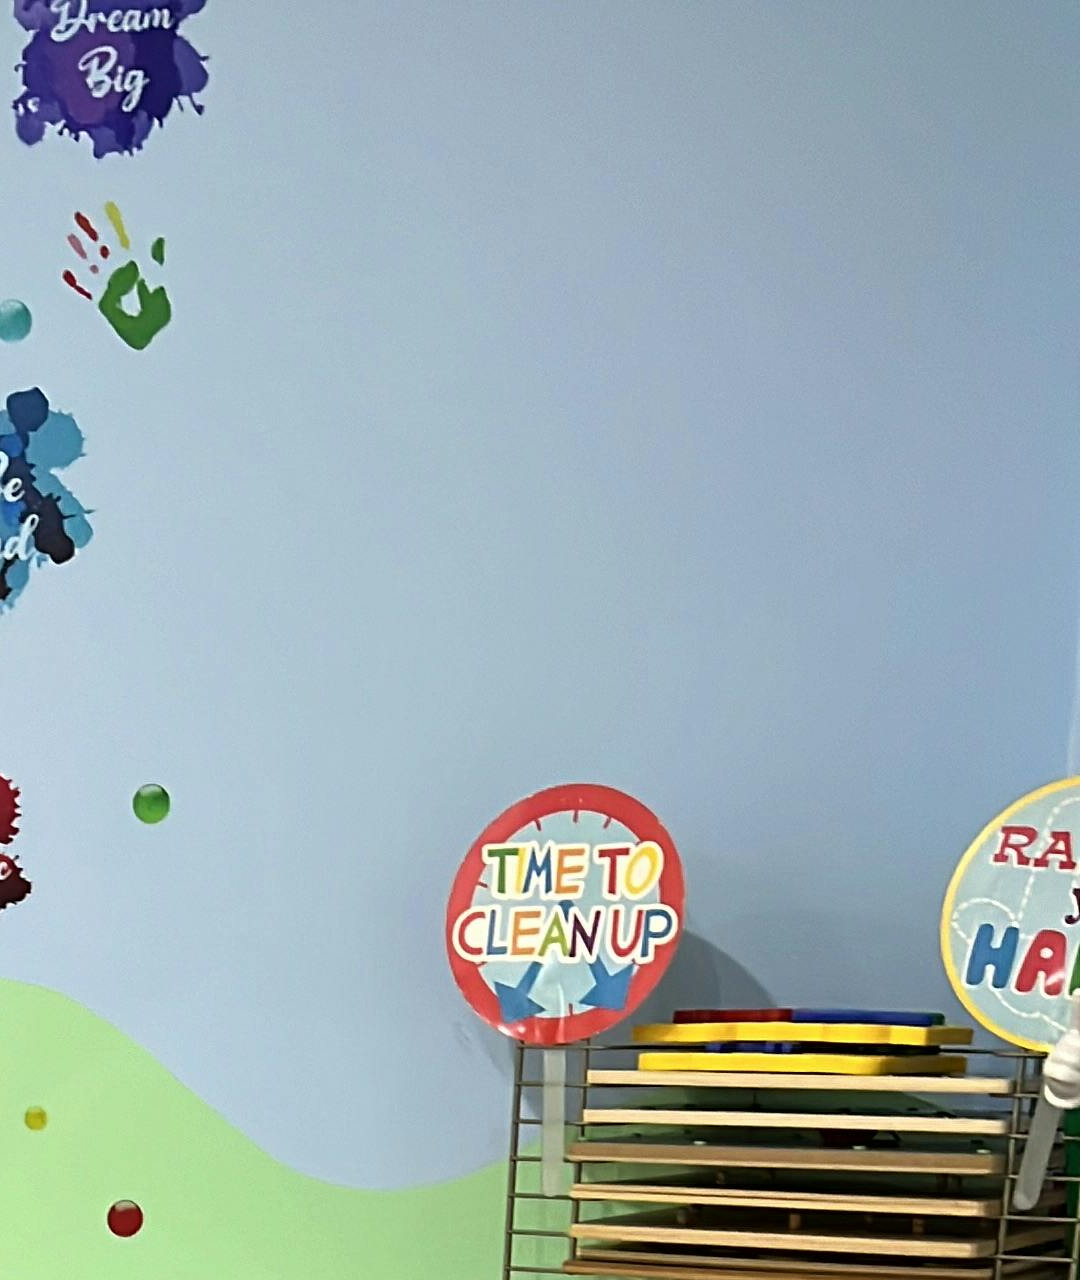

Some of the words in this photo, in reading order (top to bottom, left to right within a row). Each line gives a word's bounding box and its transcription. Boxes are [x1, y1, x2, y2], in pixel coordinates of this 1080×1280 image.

[50, 0, 174, 42] Dream
[78, 46, 150, 112] Big
[485, 846, 587, 897] TIME
[599, 844, 660, 896] TO
[993, 826, 1077, 870] RA
[457, 909, 602, 958] CLEAN
[612, 908, 672, 958] UP
[966, 923, 1080, 996] HA
